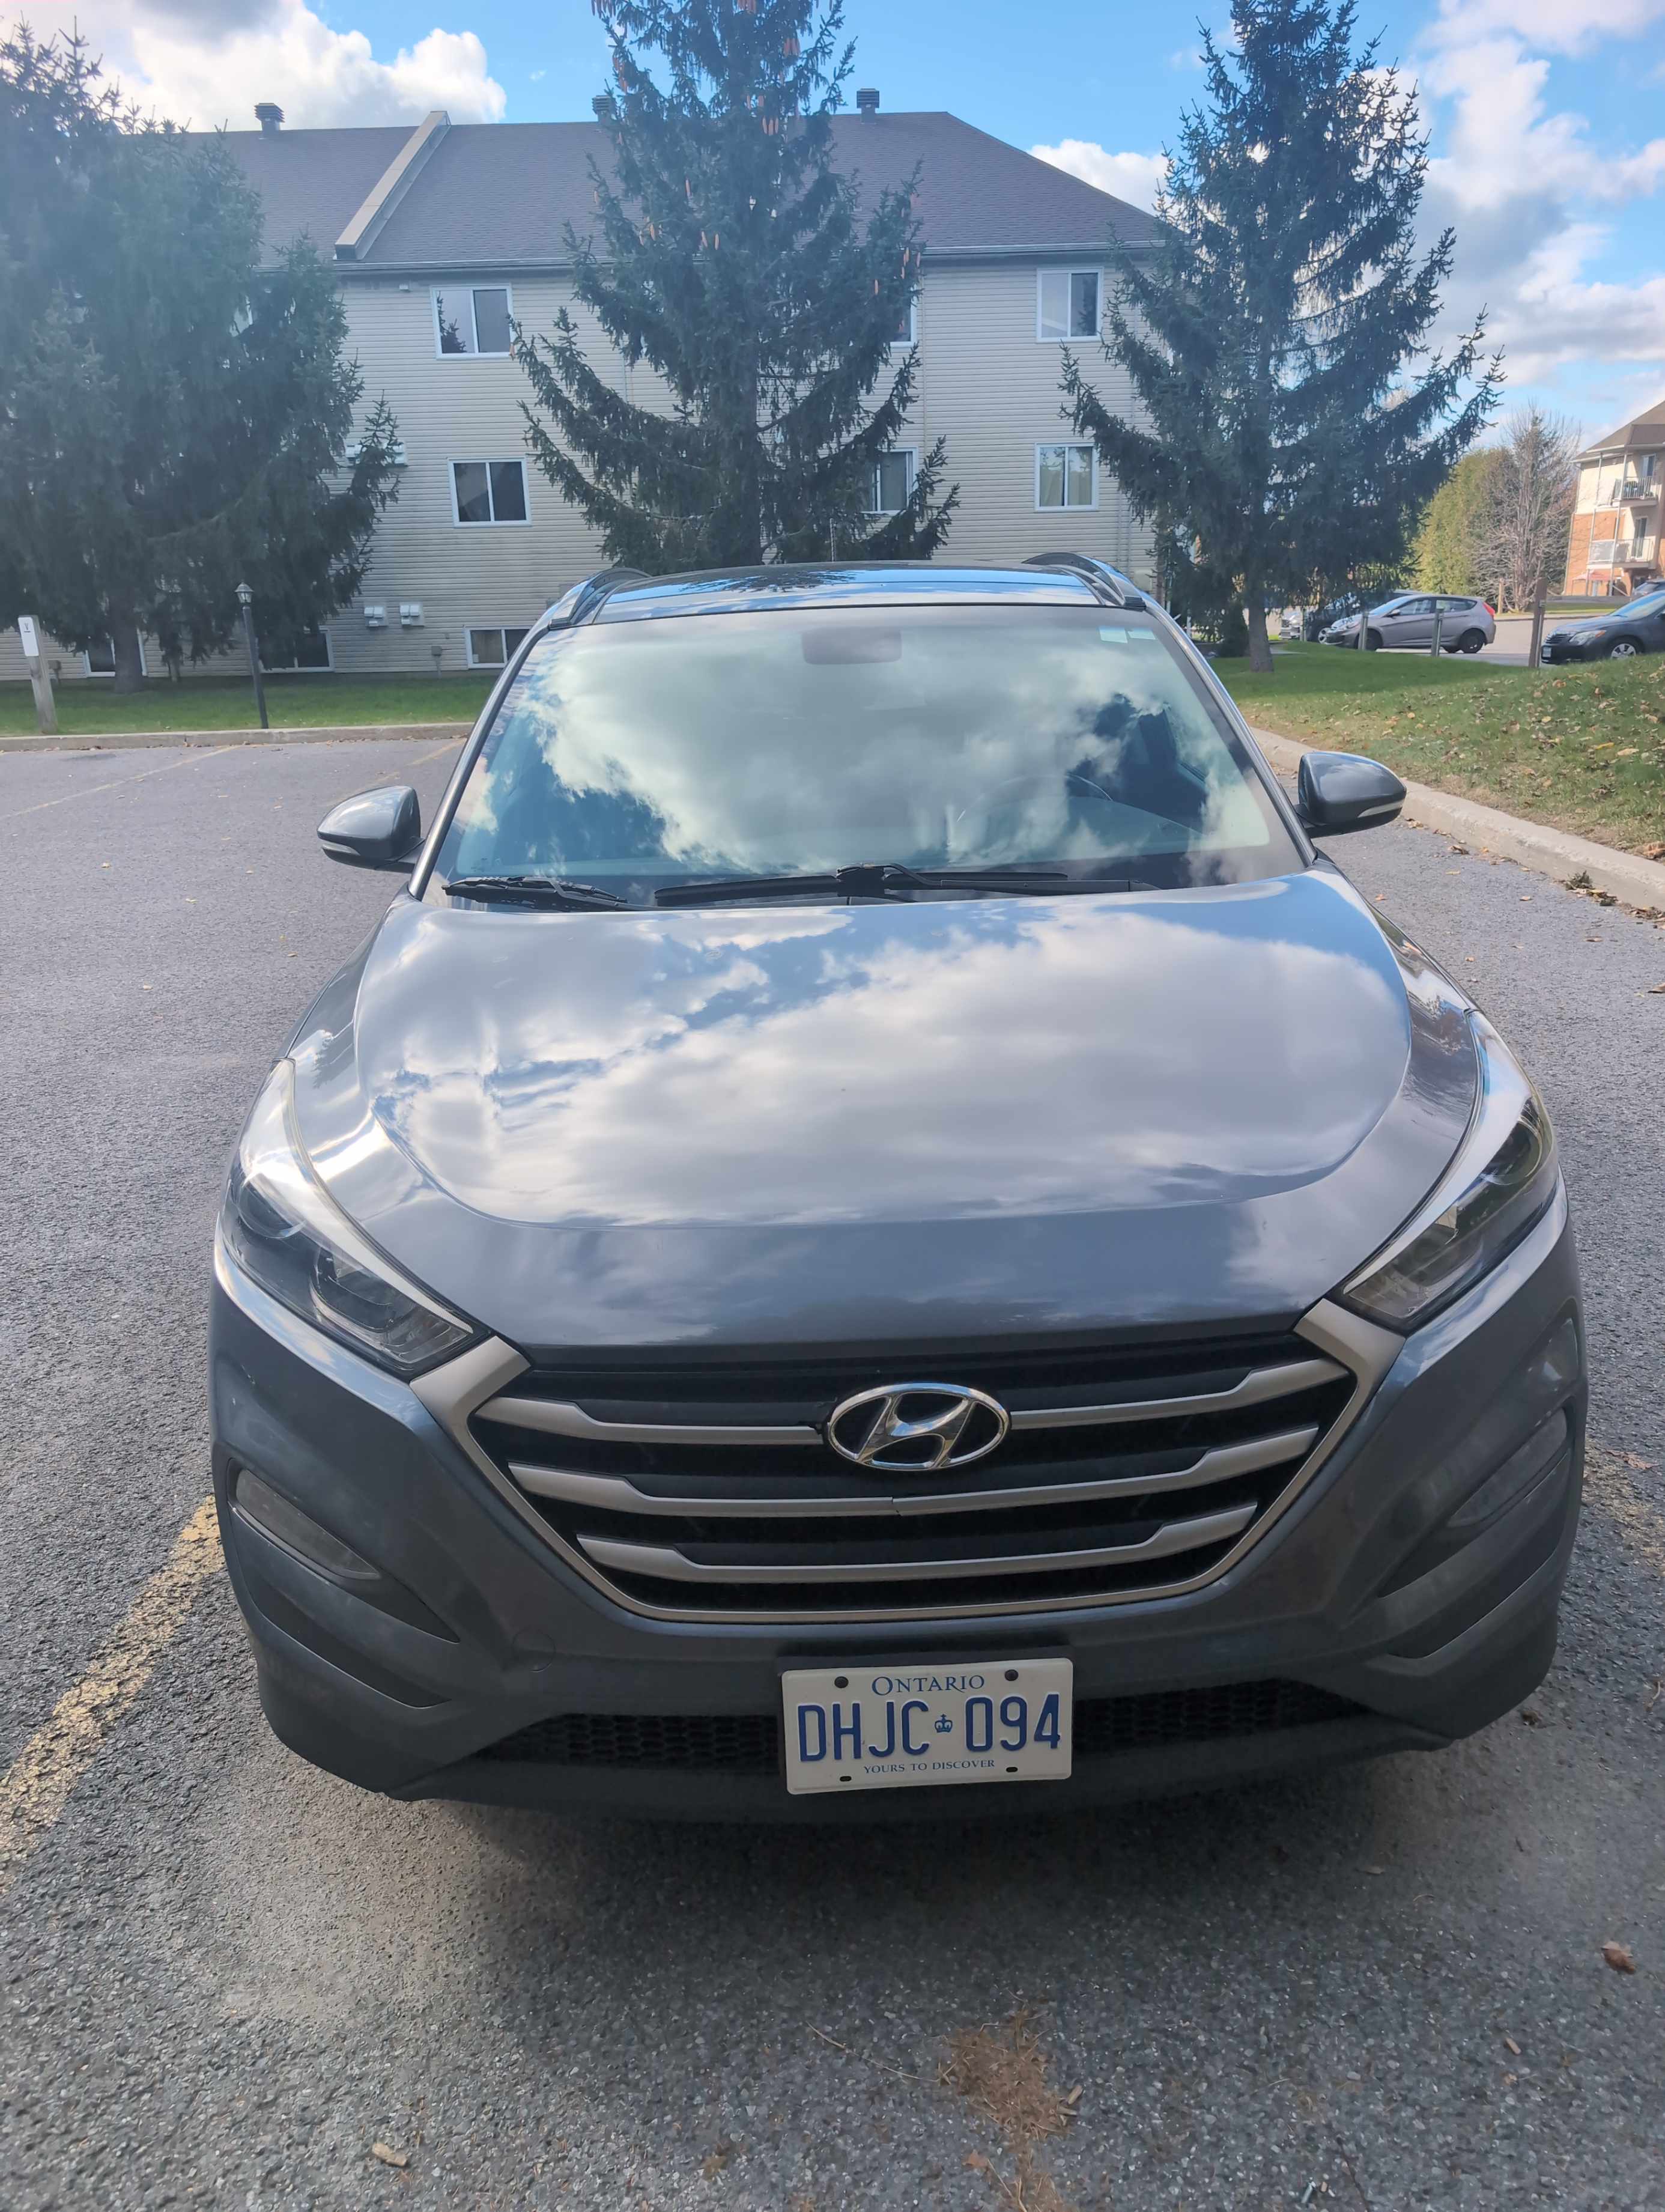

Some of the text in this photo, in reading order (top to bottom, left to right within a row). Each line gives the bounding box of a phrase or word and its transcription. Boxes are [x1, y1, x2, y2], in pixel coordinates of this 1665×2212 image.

[872, 1675, 985, 1696] ONTARIO
[798, 1694, 1061, 1762] DHJC 094
[864, 1760, 995, 1774] YOURS TO DISCOVER
